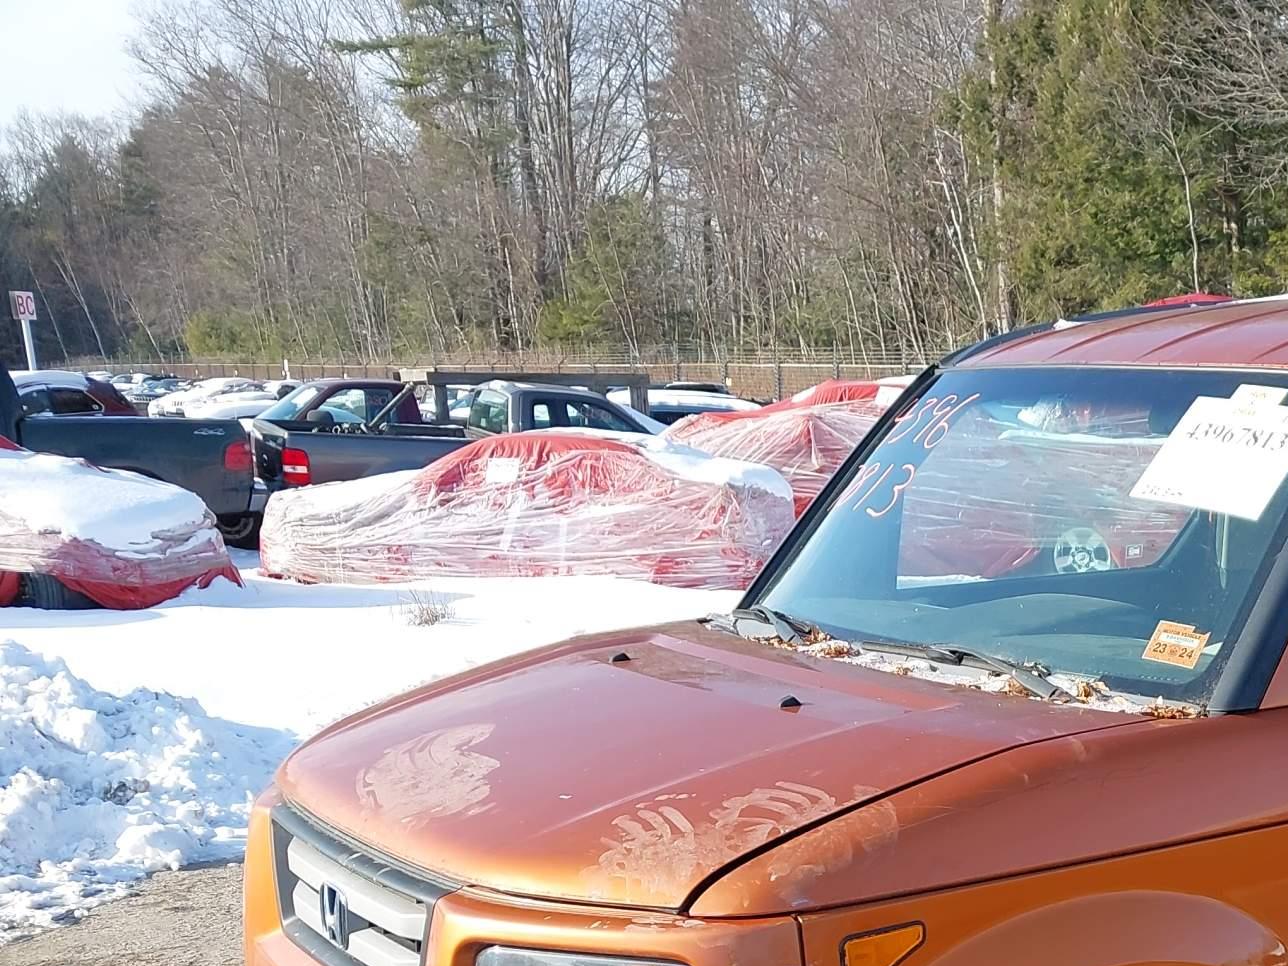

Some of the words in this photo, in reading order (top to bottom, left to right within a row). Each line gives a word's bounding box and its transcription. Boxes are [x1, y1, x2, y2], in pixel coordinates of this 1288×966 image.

[15, 294, 35, 316] BC
[1152, 641, 1168, 654] 23
[1178, 647, 1195, 660] 24
